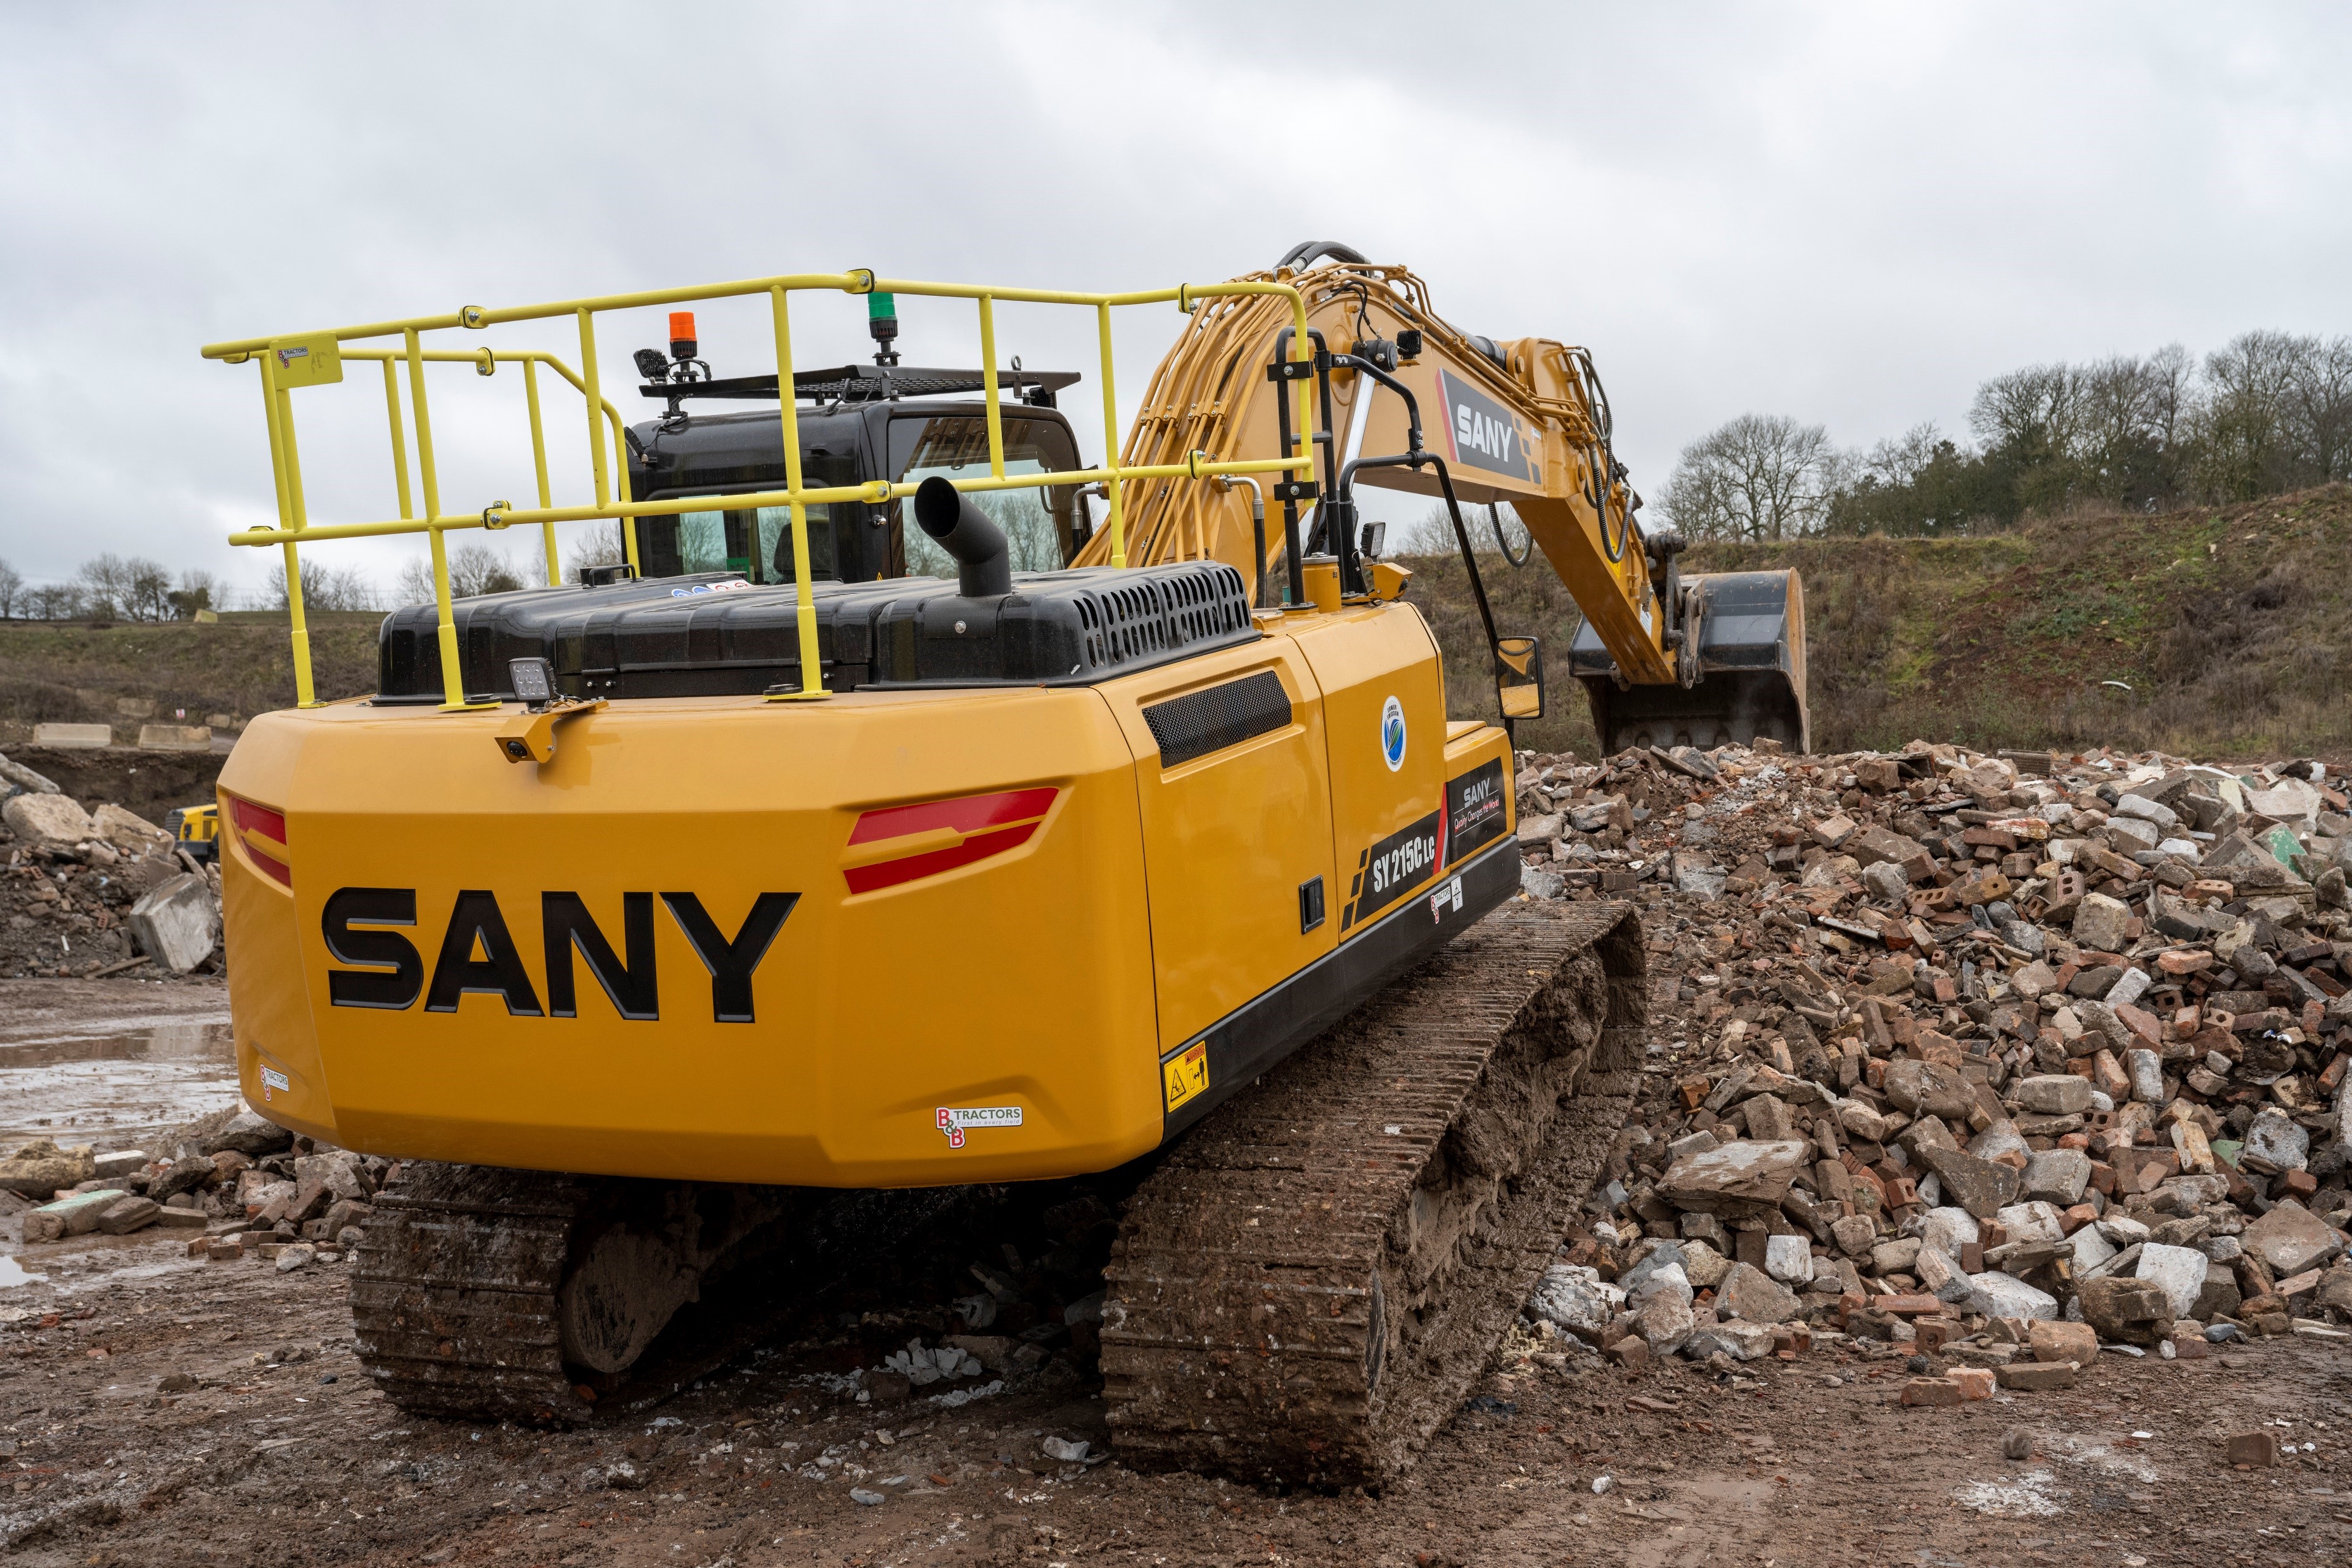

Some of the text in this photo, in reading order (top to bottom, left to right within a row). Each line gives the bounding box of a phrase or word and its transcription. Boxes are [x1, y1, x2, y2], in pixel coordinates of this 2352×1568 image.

[1458, 404, 1512, 462] SANY
[1464, 777, 1490, 808] SANY
[1454, 813, 1467, 829] Quality
[1467, 808, 1483, 822] Changes
[1489, 795, 1499, 810] World
[1435, 887, 1450, 902] TRACTORS
[321, 887, 803, 1023] SANY
[1189, 1044, 1204, 1061] WARNING
[265, 1069, 288, 1085] TRACTORS
[954, 1108, 1021, 1120] TRACTORS
